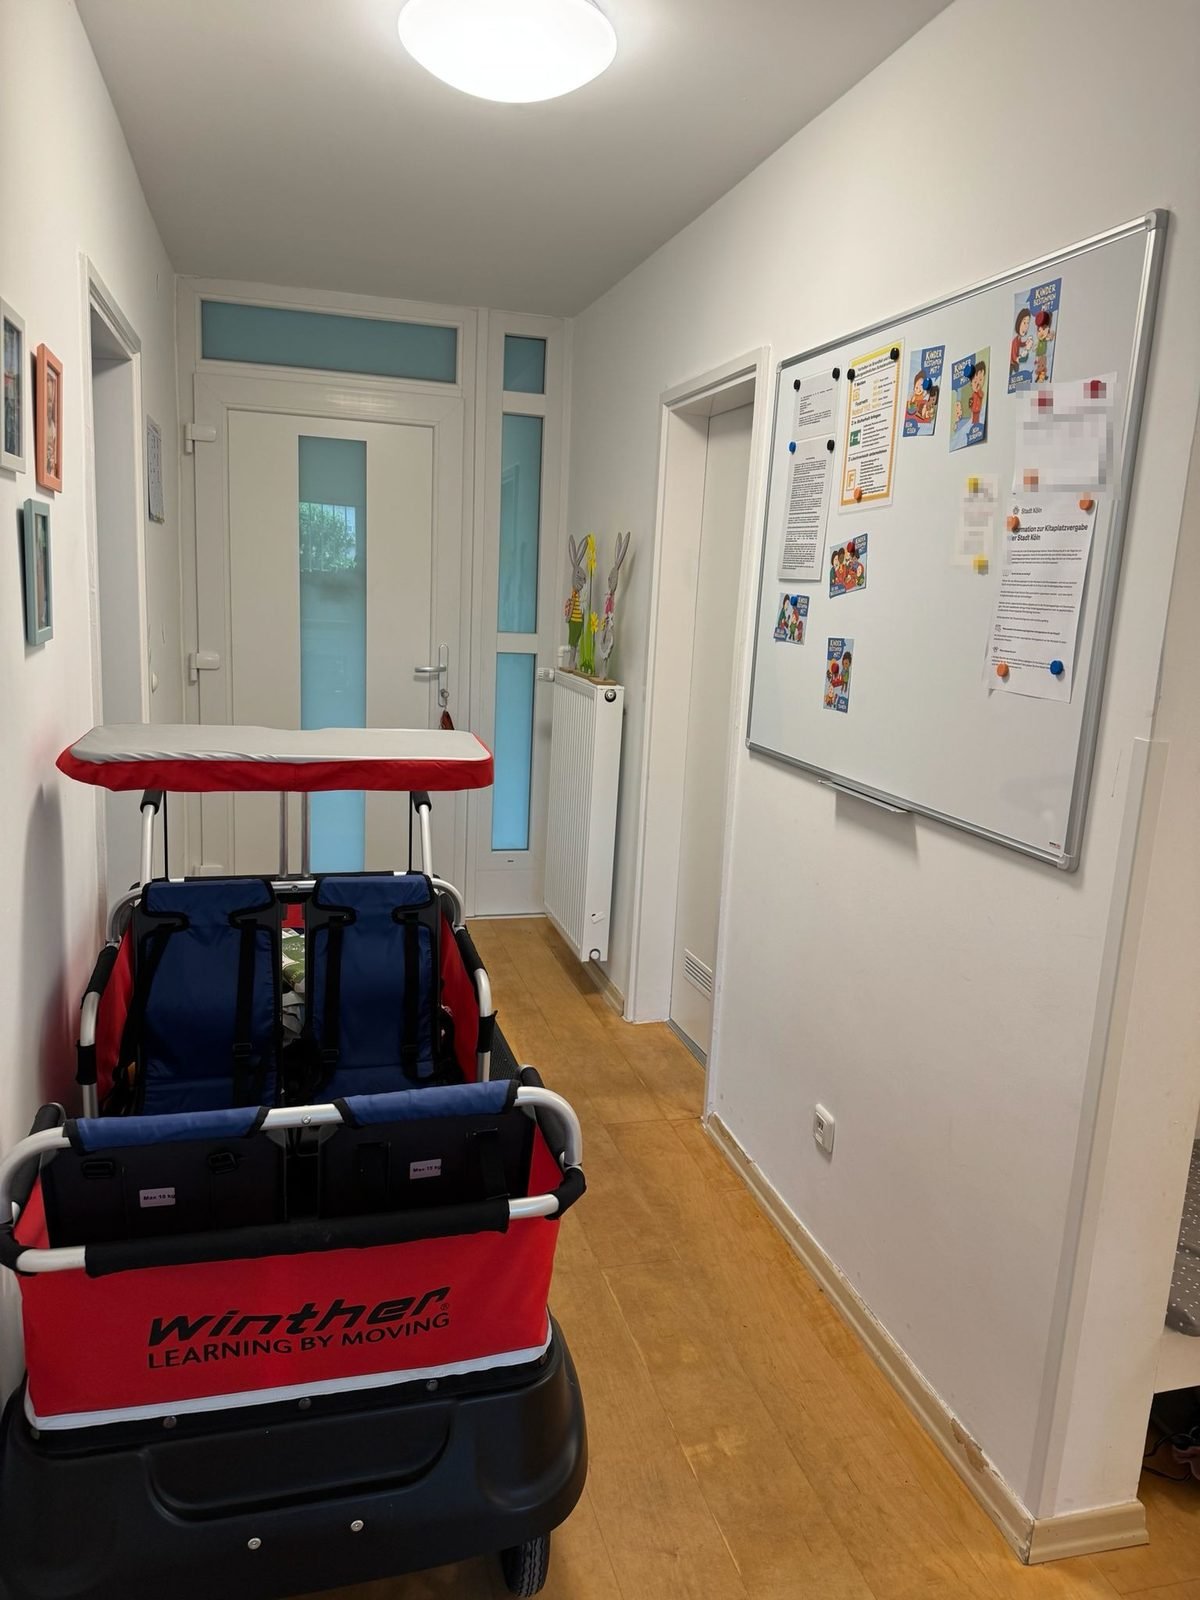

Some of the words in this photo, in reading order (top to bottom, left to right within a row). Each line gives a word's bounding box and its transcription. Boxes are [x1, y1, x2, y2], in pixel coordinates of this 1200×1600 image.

[1035, 284, 1056, 299] KINDER
[925, 349, 942, 361] KINDER
[1045, 523, 1088, 532] Kitaplatzvergabe
[147, 1339, 292, 1369] LEARNING
[300, 1335, 333, 1351] BY
[341, 1312, 449, 1346] MOVING
